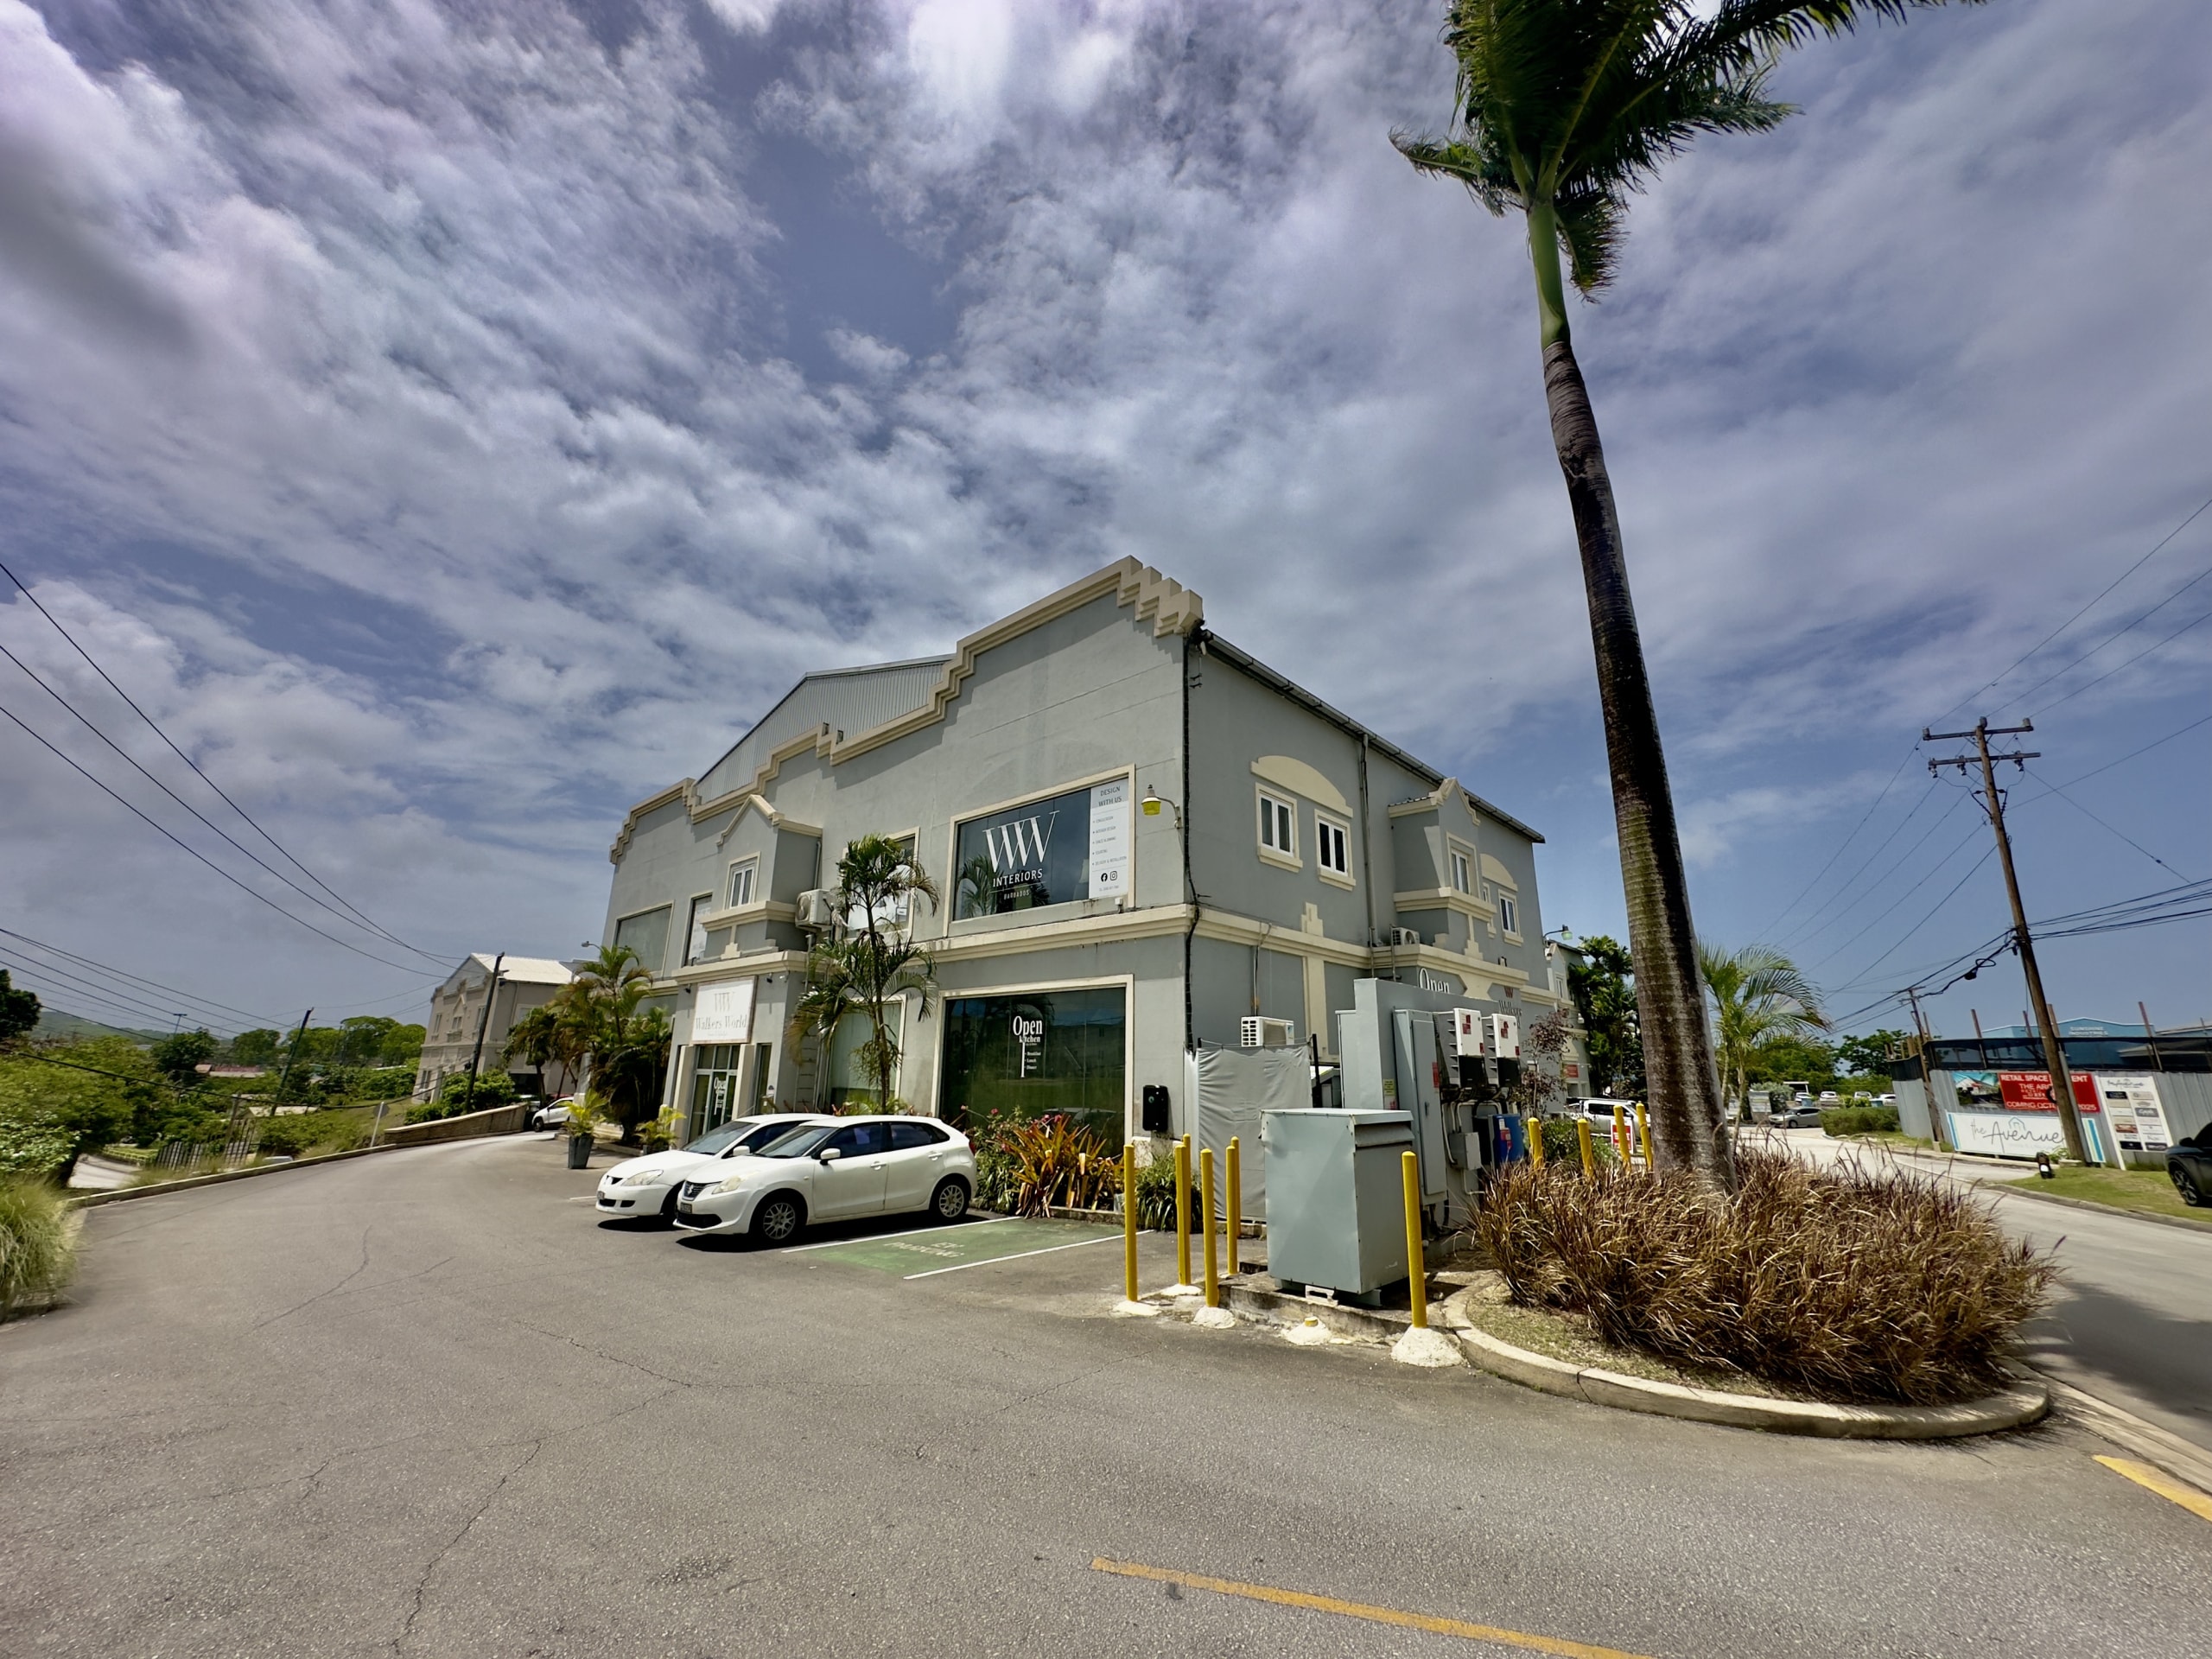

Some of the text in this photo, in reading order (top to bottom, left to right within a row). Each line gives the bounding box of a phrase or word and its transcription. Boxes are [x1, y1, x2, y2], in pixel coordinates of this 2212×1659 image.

[1100, 785, 1121, 797] DESIGN
[1098, 795, 1122, 807] WITH US
[992, 868, 1043, 887] INTERIORS
[1003, 889, 1030, 900] BARBADOS
[696, 1014, 747, 1031] Walkers World
[1013, 1015, 1043, 1036] Open
[2019, 1084, 2035, 1092] THE
[1970, 1118, 2064, 1154] the Avenue
